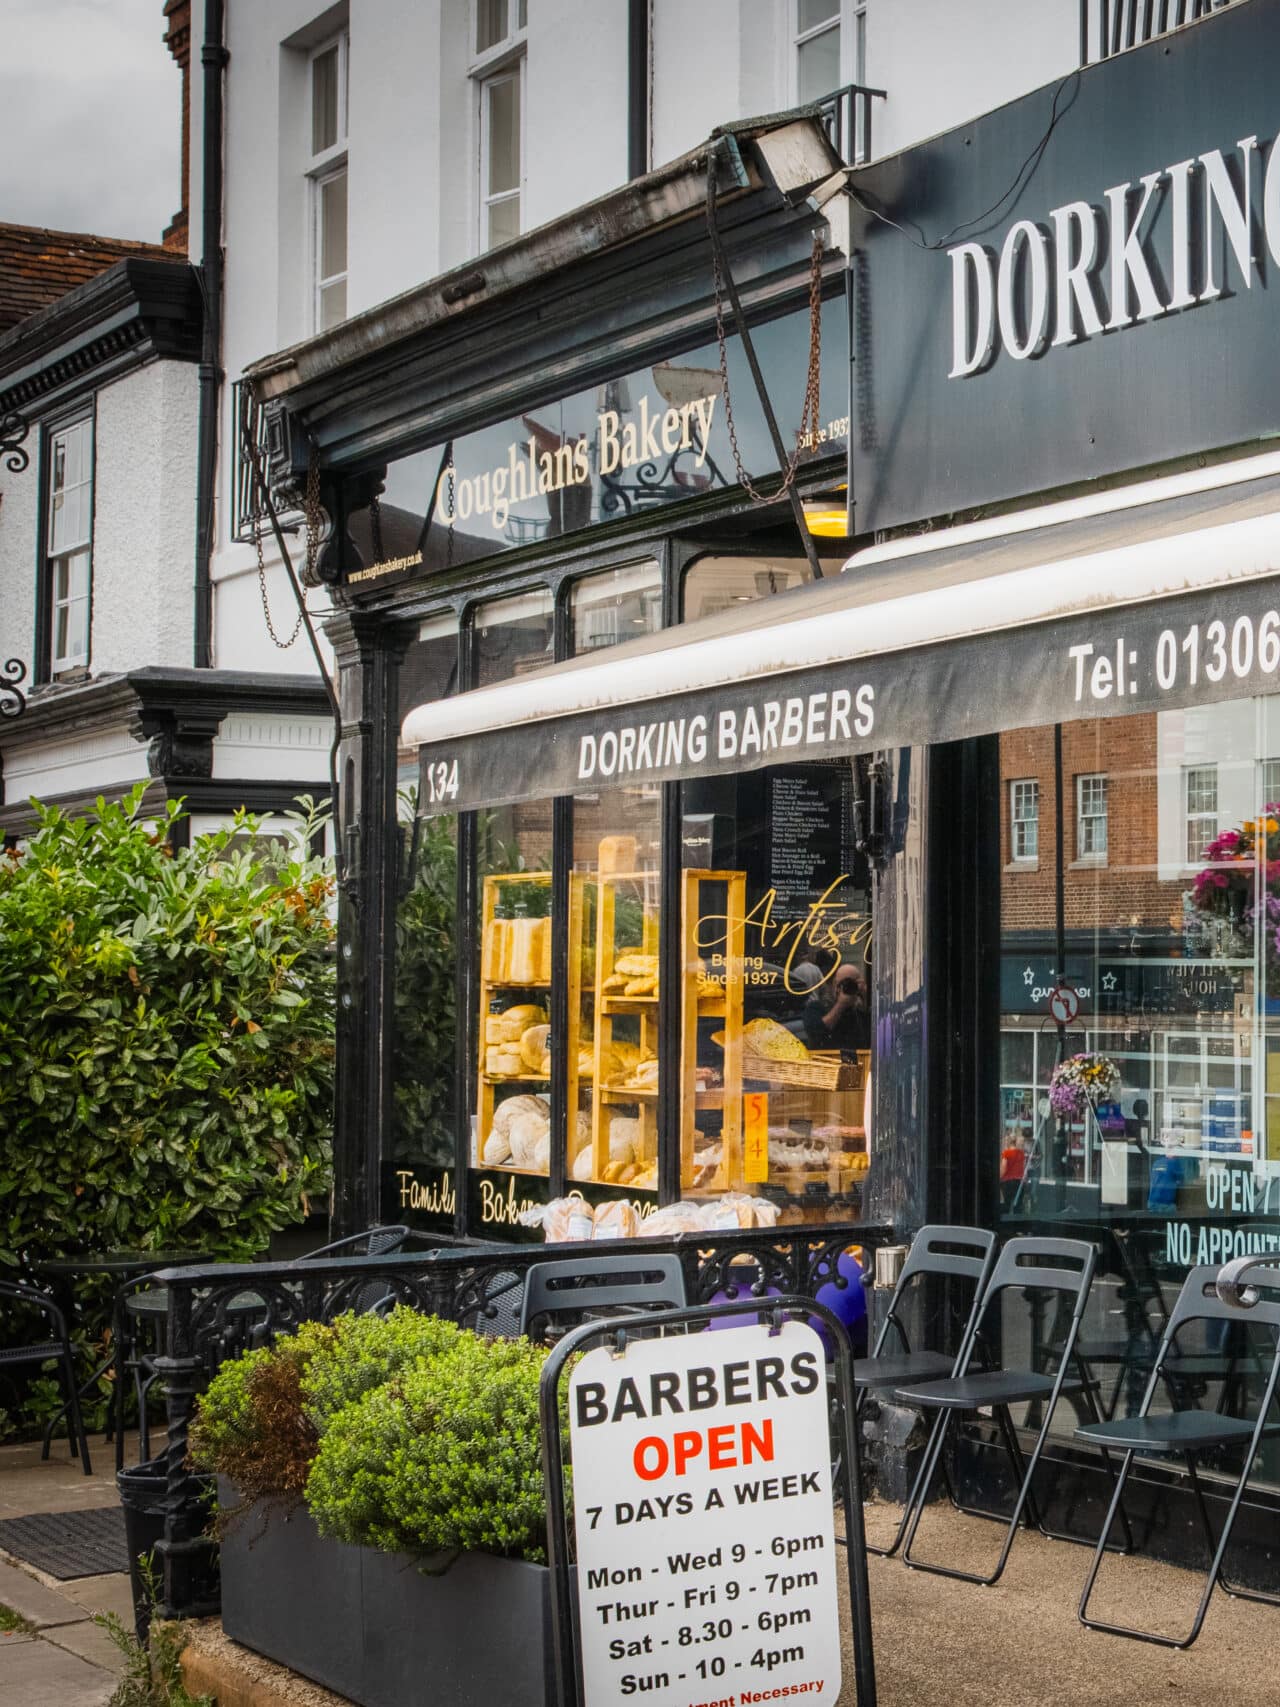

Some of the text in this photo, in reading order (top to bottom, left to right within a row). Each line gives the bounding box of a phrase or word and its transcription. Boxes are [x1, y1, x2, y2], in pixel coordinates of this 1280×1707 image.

[435, 393, 718, 529] Coughlans Bakery
[1069, 638, 1137, 701] Tel:
[1156, 610, 1280, 690] 01306
[427, 684, 875, 802] 134 DORKING BARBERS
[696, 972, 777, 985] Since 1937
[1206, 1167, 1254, 1213] OPEN
[1263, 1170, 1271, 1215] 7
[1167, 1222, 1191, 1265] NO
[575, 1351, 820, 1428] BARBERS
[633, 1419, 775, 1481] OPEN
[586, 1471, 822, 1530] 7 DAYS A WEEK
[587, 1565, 642, 1590] Mon
[667, 1547, 723, 1575] Wed
[731, 1543, 745, 1563] 9
[771, 1533, 824, 1559] 6pm
[597, 1600, 659, 1625] Thur
[684, 1585, 716, 1609] Fri
[725, 1580, 740, 1601] 9
[765, 1569, 818, 1596] 7pm
[609, 1635, 653, 1660] Sat
[678, 1619, 733, 1647] 8.30
[758, 1607, 811, 1633] 6pm
[621, 1672, 669, 1695] Sun
[695, 1656, 725, 1679] 10
[750, 1645, 804, 1671] 4pm
[741, 1680, 825, 1703] Necessary
